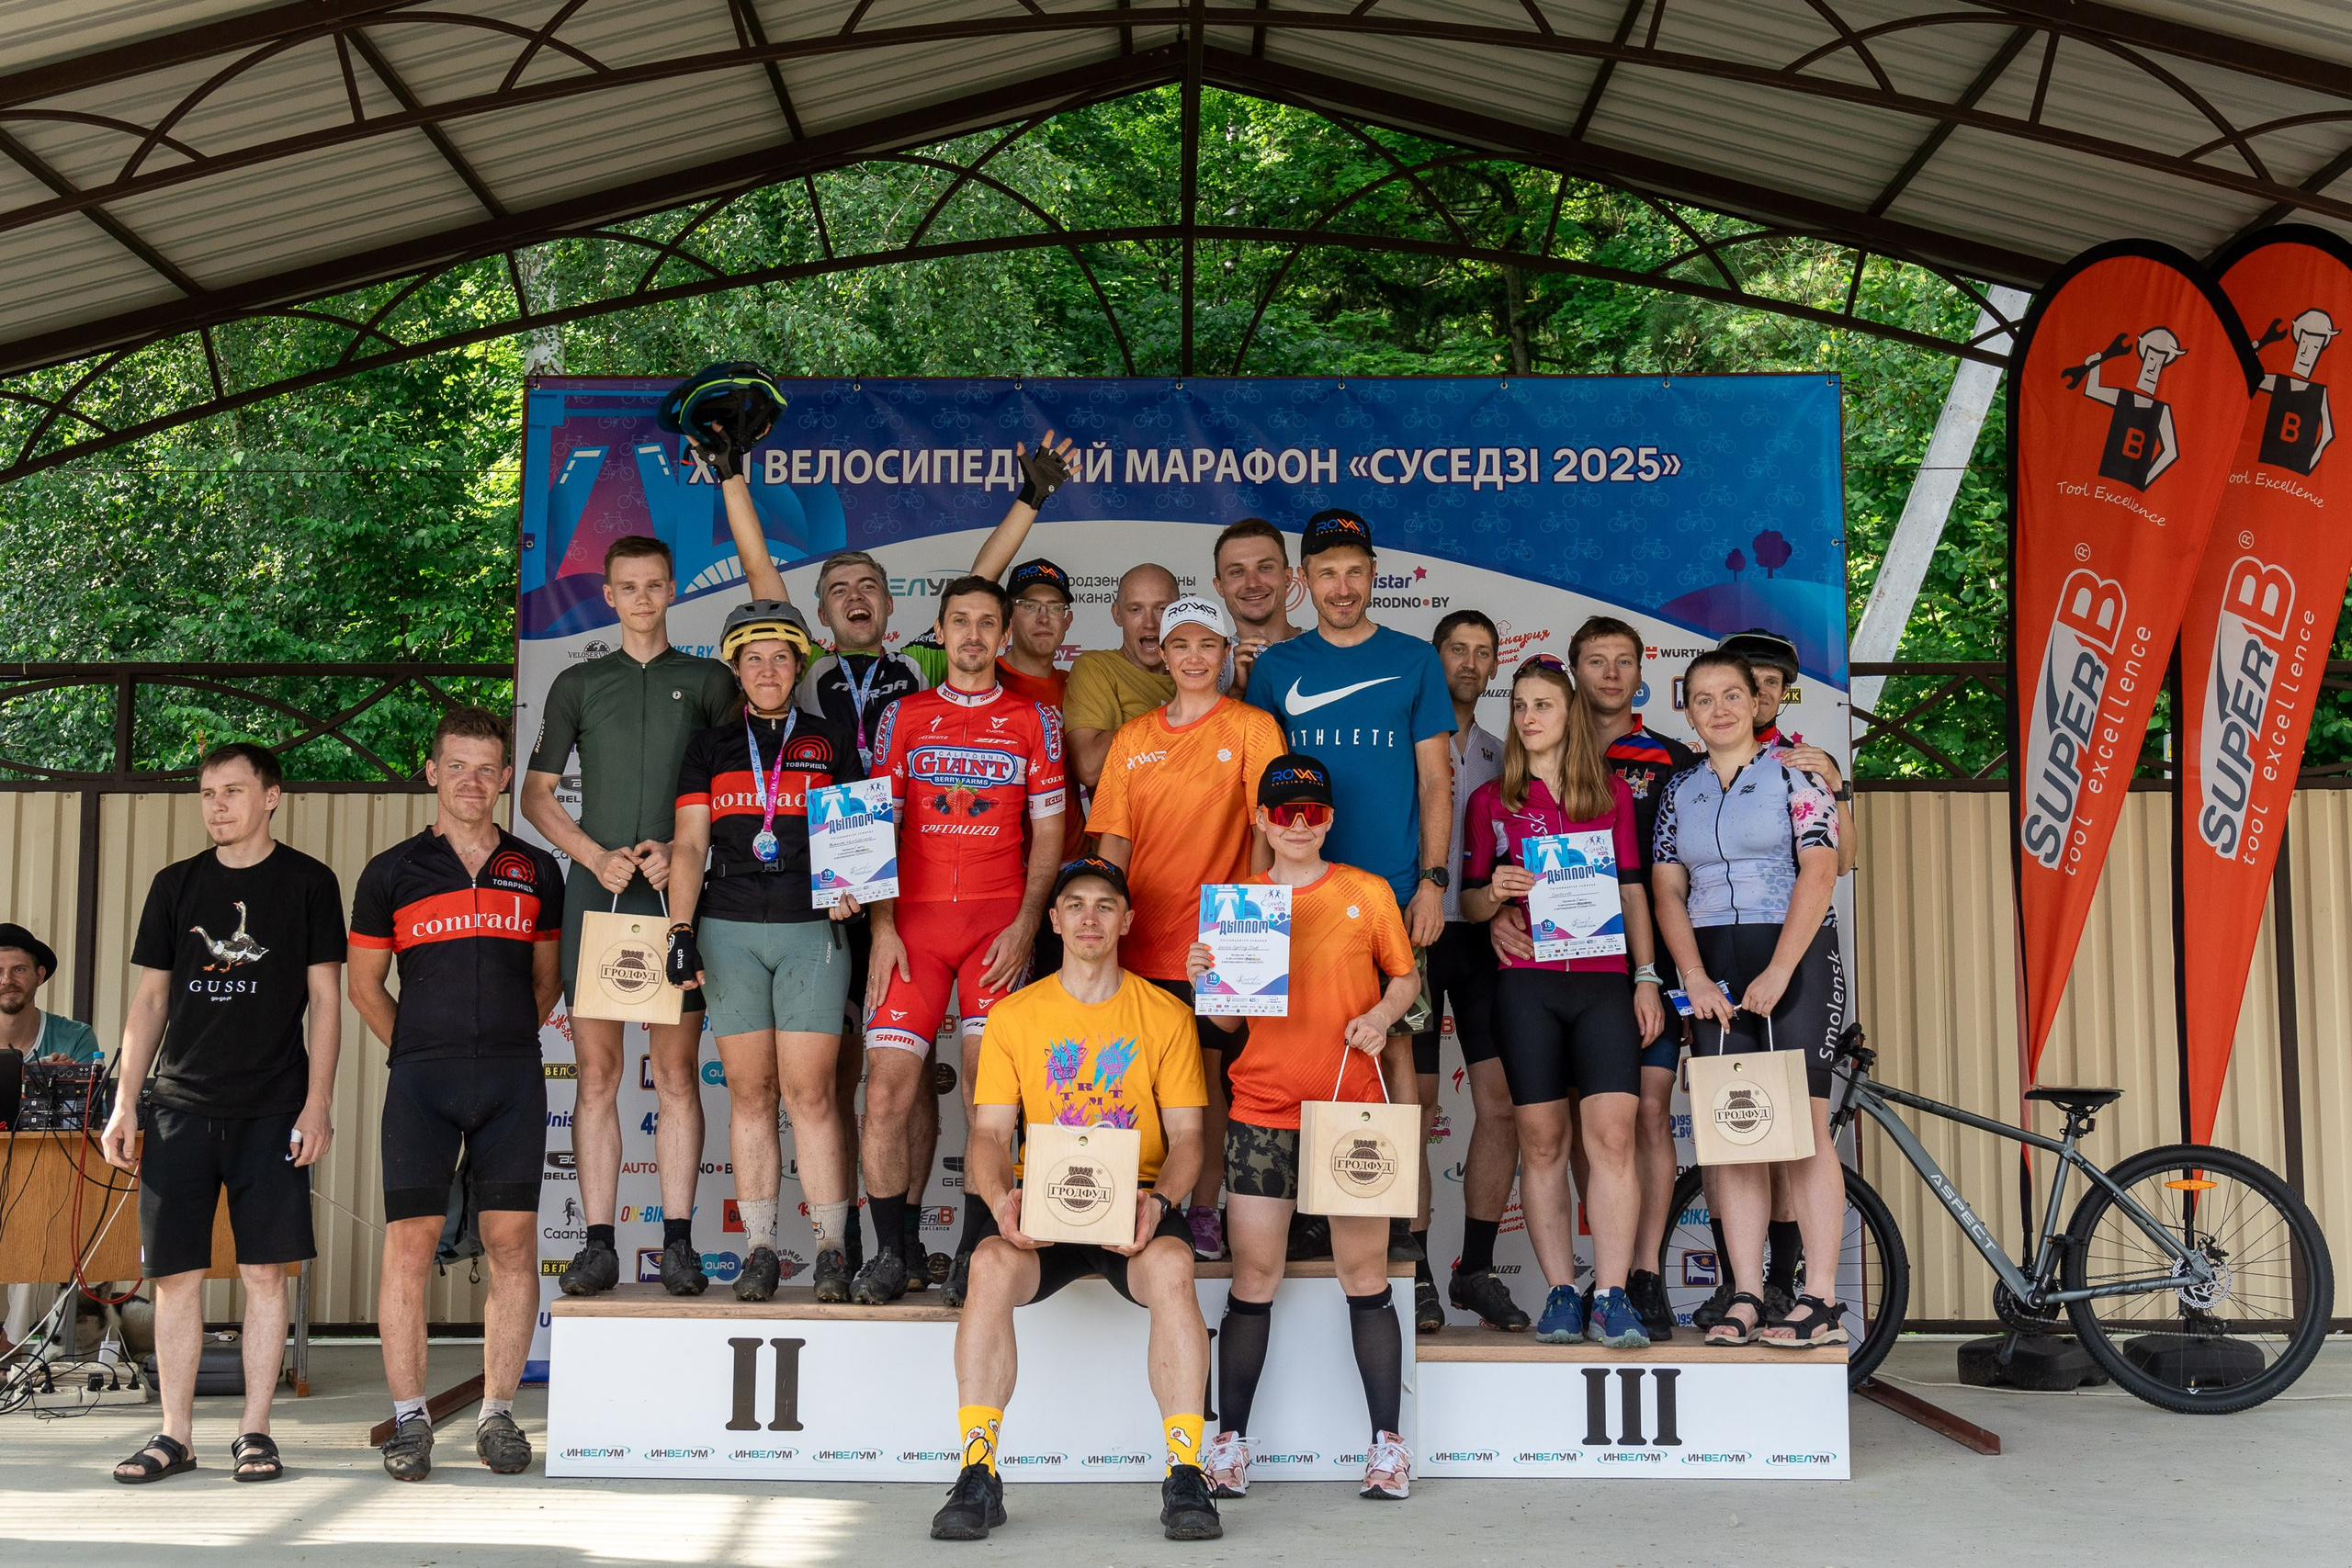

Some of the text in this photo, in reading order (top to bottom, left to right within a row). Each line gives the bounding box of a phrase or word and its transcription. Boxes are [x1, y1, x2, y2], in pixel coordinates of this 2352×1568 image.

[1125, 446, 1337, 483] МАРАФОН
[1554, 447, 1681, 482] 2025»
[2229, 471, 2252, 485] ool
[2057, 481, 2167, 527] Tool Excellence
[2263, 610, 2315, 782] excellence
[2088, 626, 2152, 794] excellence
[1292, 728, 1394, 748] ATHLETE
[939, 750, 1006, 761] CALIFORNIA
[912, 750, 1010, 780] GIANT
[963, 778, 989, 786] FARMS
[558, 795, 582, 804] BEL
[712, 775, 810, 811] comad
[921, 824, 1001, 837] SPECIALIZED
[492, 878, 534, 893] ТОВАРИЩЪ
[413, 896, 533, 938] comrade
[1219, 920, 1269, 935] ДЫПЛОМ
[604, 967, 657, 981] ГРОДФУД
[188, 979, 257, 994] GUSSI
[1819, 949, 1845, 1063] Smolensk
[876, 1034, 915, 1046] SRAM
[1718, 1110, 1770, 1121] ГРОДФУД
[1336, 1159, 1392, 1173] ГРОДФУД
[544, 1172, 577, 1180] BELG
[942, 1178, 965, 1187] GE
[1050, 1186, 1107, 1201] ГРОДФУД
[1929, 1173, 1997, 1251] ASPECT
[543, 1227, 588, 1239] Caanb
[725, 1337, 807, 1431] II
[1580, 1367, 1683, 1447] III
[567, 1449, 624, 1458] ИНВЕЛУМ
[650, 1449, 708, 1458] ИНВЕЛУМ
[735, 1449, 793, 1459] ИНВЕЛУМ
[819, 1450, 876, 1460] ИНВЕЛУМ
[903, 1450, 960, 1461] ИНВЕЛУМ
[1004, 1454, 1062, 1464] ИНВЕЛУМ
[1088, 1454, 1146, 1464] ИНВЕЛУМ
[1256, 1454, 1314, 1464] ИНВЕЛУМ
[1435, 1452, 1829, 1463] ИНВЕЛУМ ИНВЕЛУМ ИНВЕЛУМ ИНВЕЛУМ ИНВЕЛУМ
